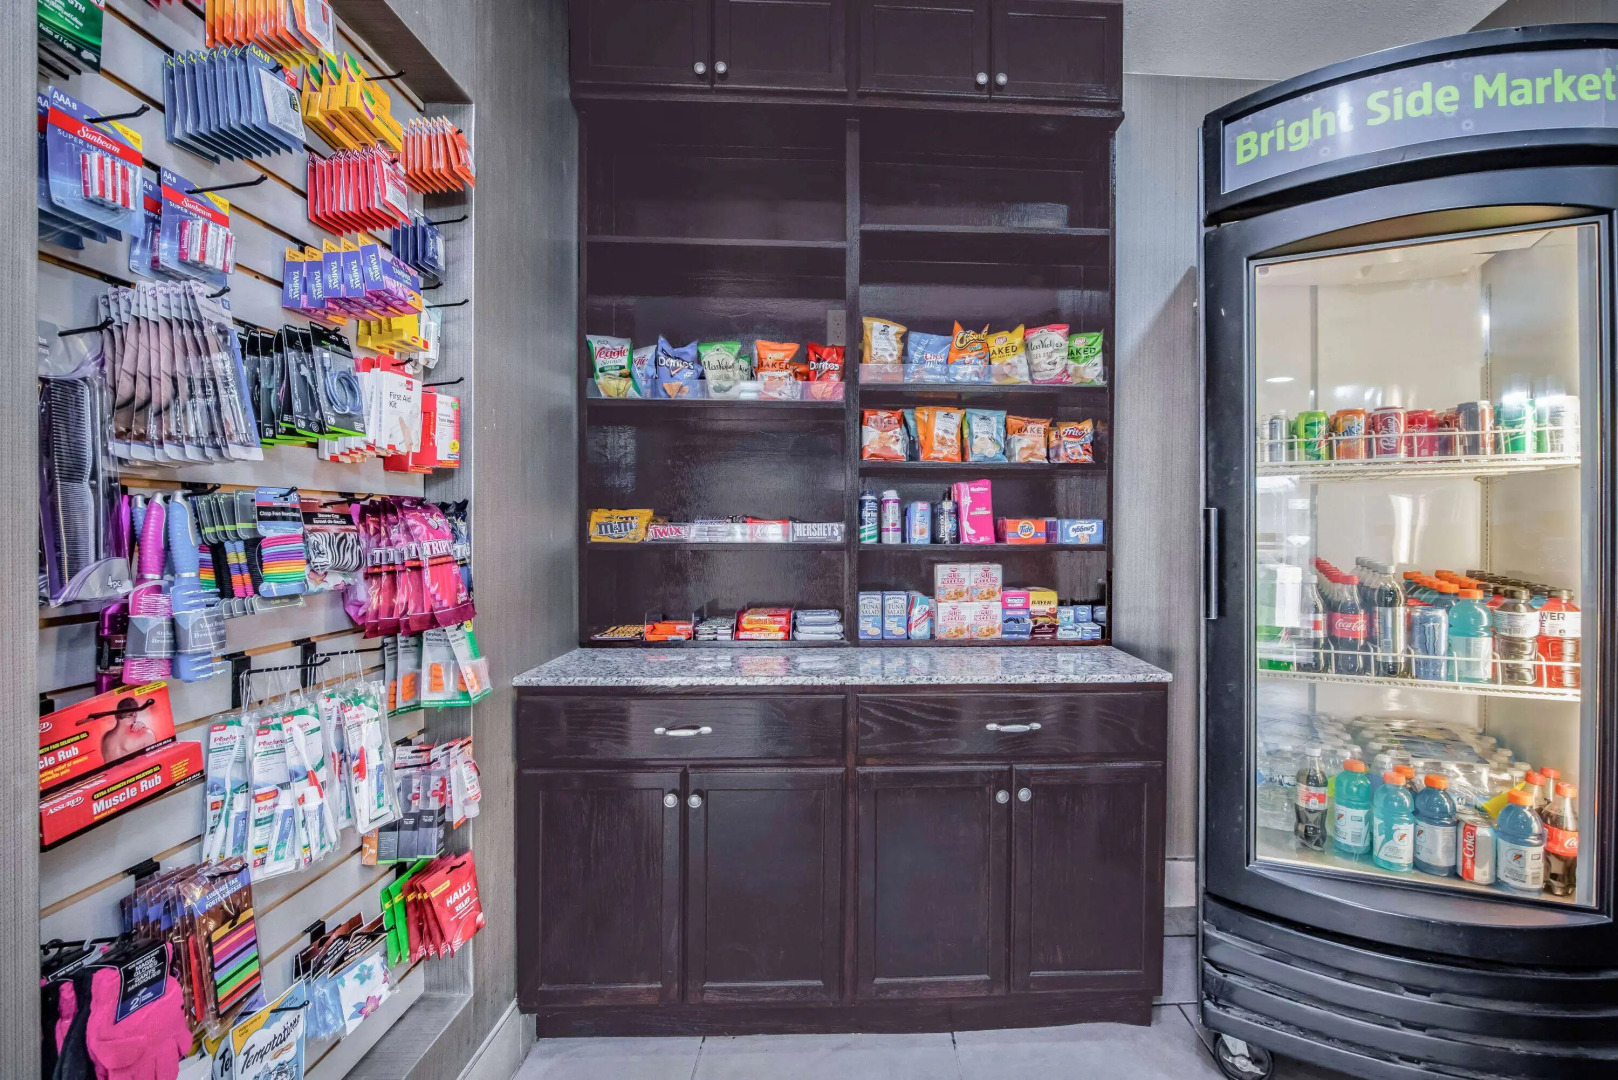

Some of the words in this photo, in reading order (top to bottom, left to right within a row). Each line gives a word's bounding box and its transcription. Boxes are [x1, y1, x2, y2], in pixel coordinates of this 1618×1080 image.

[250, 44, 271, 64] Advil
[53, 91, 72, 107] AAA
[1235, 106, 1355, 166] Bright
[1366, 81, 1460, 126] Side
[1473, 64, 1616, 109] Market
[57, 129, 85, 146] SUPER
[77, 126, 121, 153] Sunbeam
[181, 198, 212, 217] Sunbeam
[330, 260, 340, 290] TAMPAX
[350, 259, 361, 290] TAMPAX
[371, 252, 382, 282] TAMPAX
[292, 270, 300, 301] TAMPAX
[594, 346, 629, 361] Veggie
[658, 356, 694, 370] Doritos
[809, 361, 841, 371] Doritos
[389, 391, 402, 402] First
[402, 393, 412, 403] Aid
[389, 400, 397, 409] Kit
[290, 493, 299, 502] 15
[794, 522, 839, 537] HERSHEY'S
[1019, 525, 1034, 534] Tide
[1071, 524, 1095, 534] Snuggle
[107, 578, 122, 590] 4pc
[1335, 617, 1367, 632] Coca-Cola
[57, 746, 79, 762] Rub
[92, 787, 138, 815] Muscle
[140, 774, 162, 793] Rub
[47, 796, 85, 816] ASSURED
[1463, 831, 1475, 858] Coke
[446, 881, 471, 908] HALLS
[134, 960, 158, 978] GLOVES
[136, 956, 156, 970] MAGIC
[129, 997, 140, 1012] 2
[241, 1014, 301, 1075] Temptations
